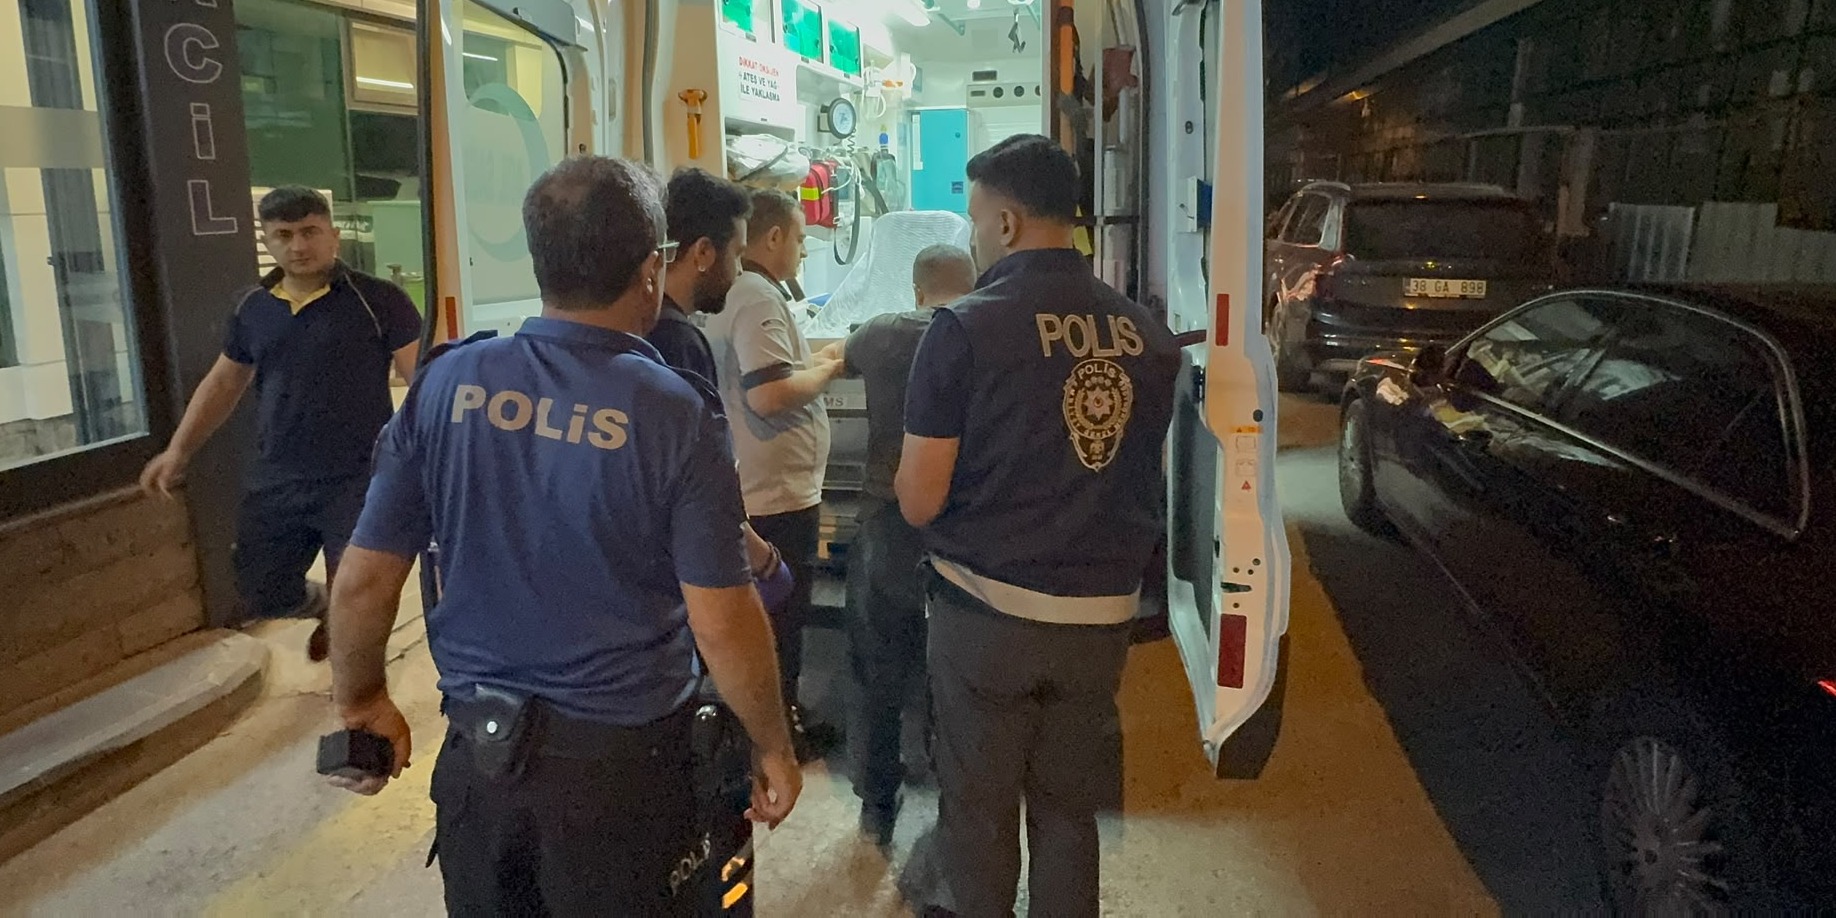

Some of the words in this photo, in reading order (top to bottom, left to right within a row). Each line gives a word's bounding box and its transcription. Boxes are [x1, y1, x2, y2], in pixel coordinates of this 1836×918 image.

[1412, 280, 1427, 292] 38
[1434, 281, 1449, 293] GA
[1460, 281, 1484, 294] 898
